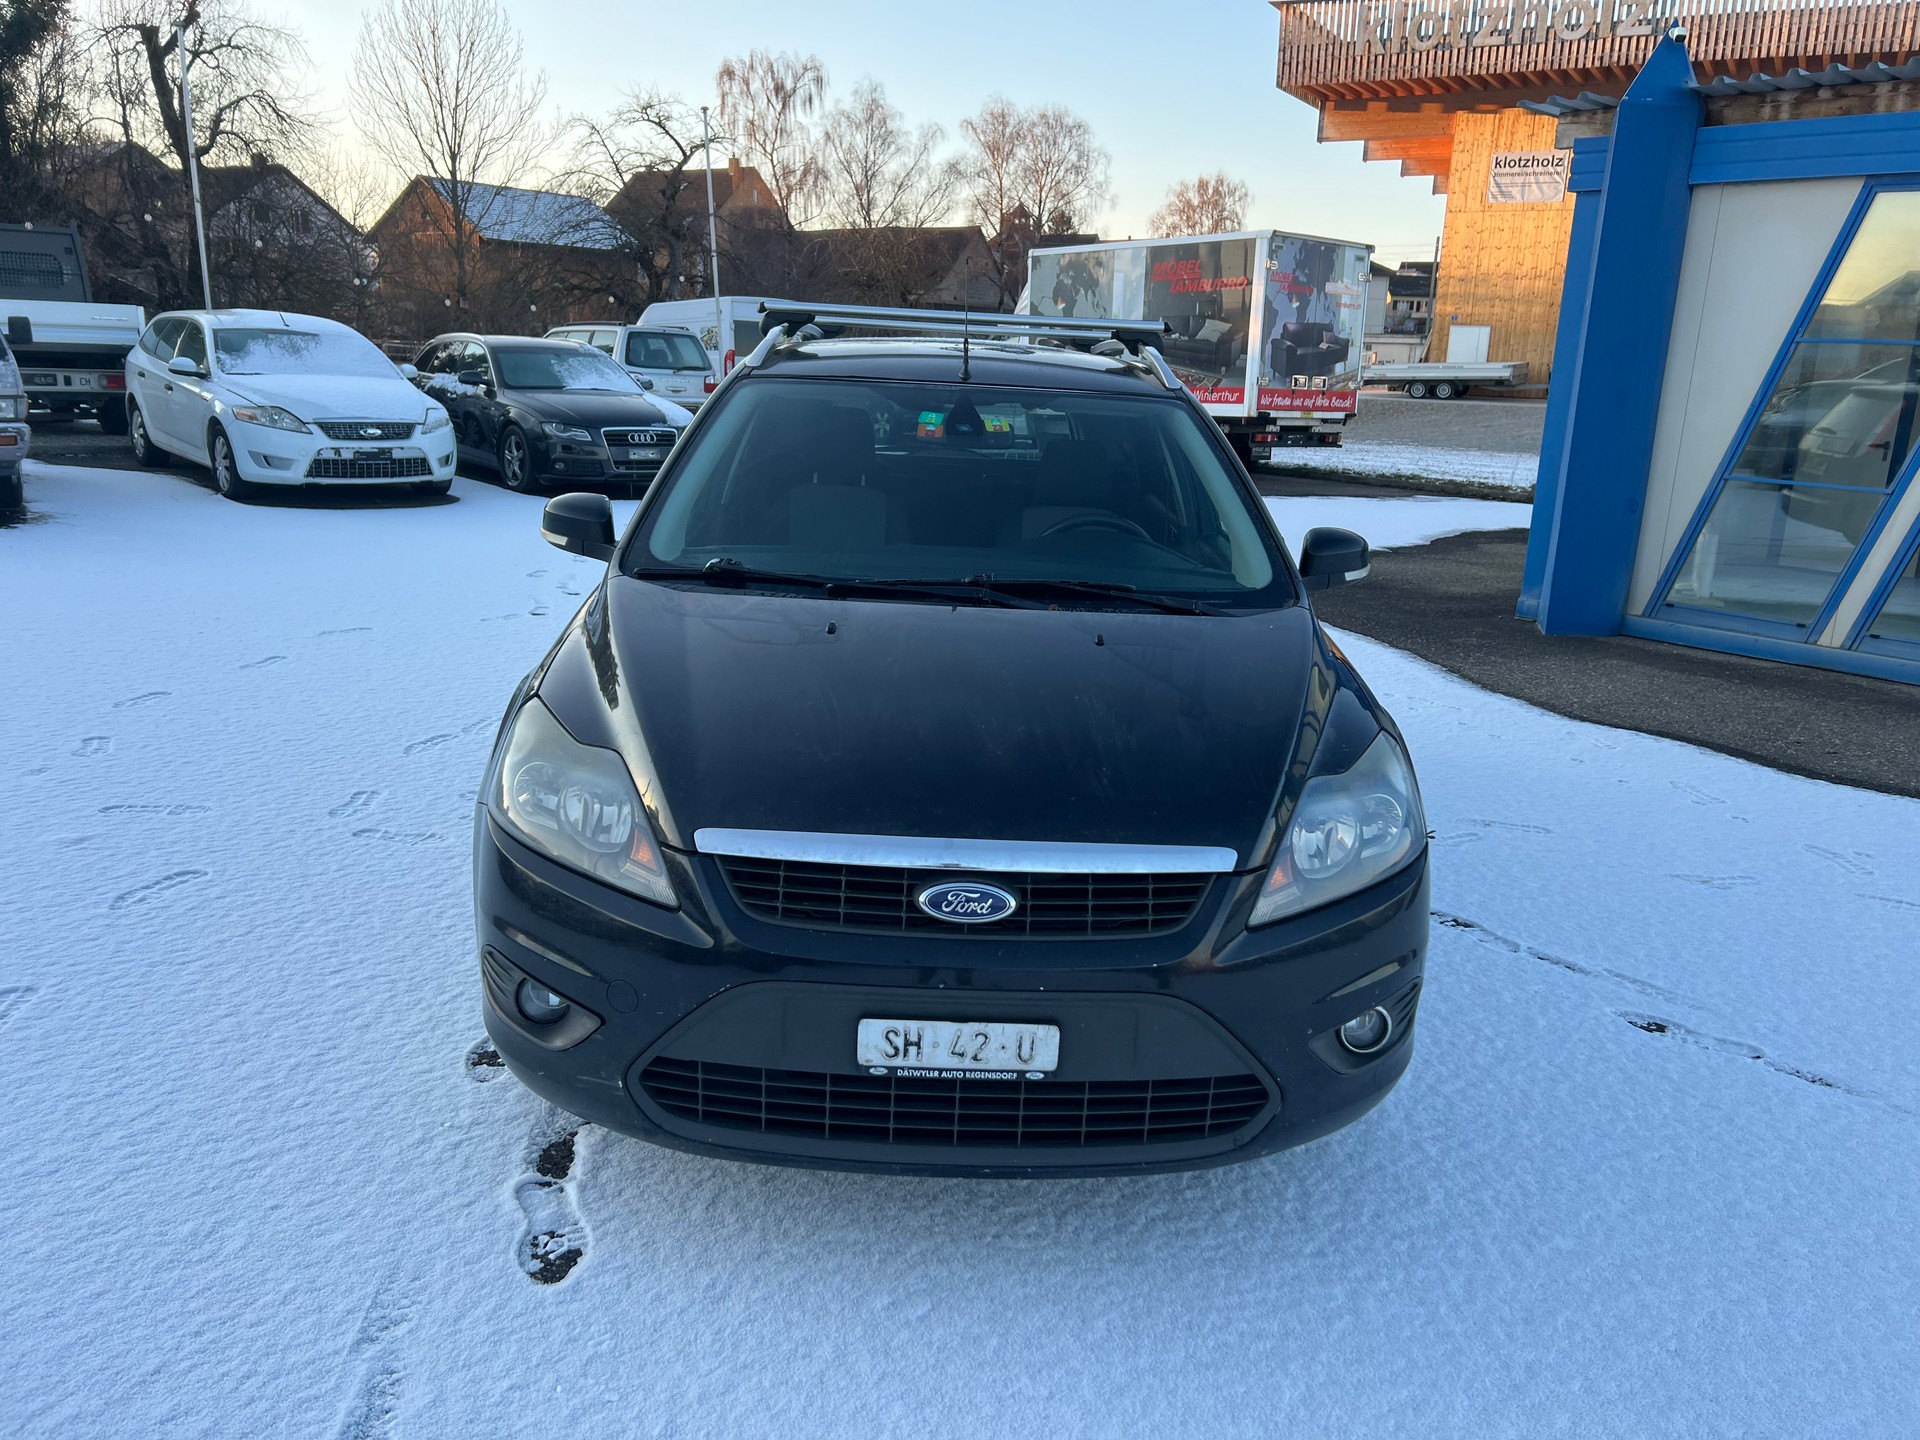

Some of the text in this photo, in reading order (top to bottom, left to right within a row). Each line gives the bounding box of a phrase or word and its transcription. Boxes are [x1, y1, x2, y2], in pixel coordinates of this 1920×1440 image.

[1354, 0, 1653, 56] klotzholz
[1494, 155, 1564, 169] klotzholz
[1153, 259, 1201, 274] MÖBEL
[1169, 276, 1248, 294] TAMBURRO
[79, 377, 91, 386] CH
[1193, 390, 1240, 402] Winterthur
[1260, 393, 1272, 405] Wir
[1272, 393, 1292, 407] freuen
[941, 890, 993, 914] Ford
[883, 1028, 924, 1061] SH
[949, 1028, 990, 1064] 42
[897, 1067, 1018, 1080] DÄTWYLER AUTO REGENSDORF
